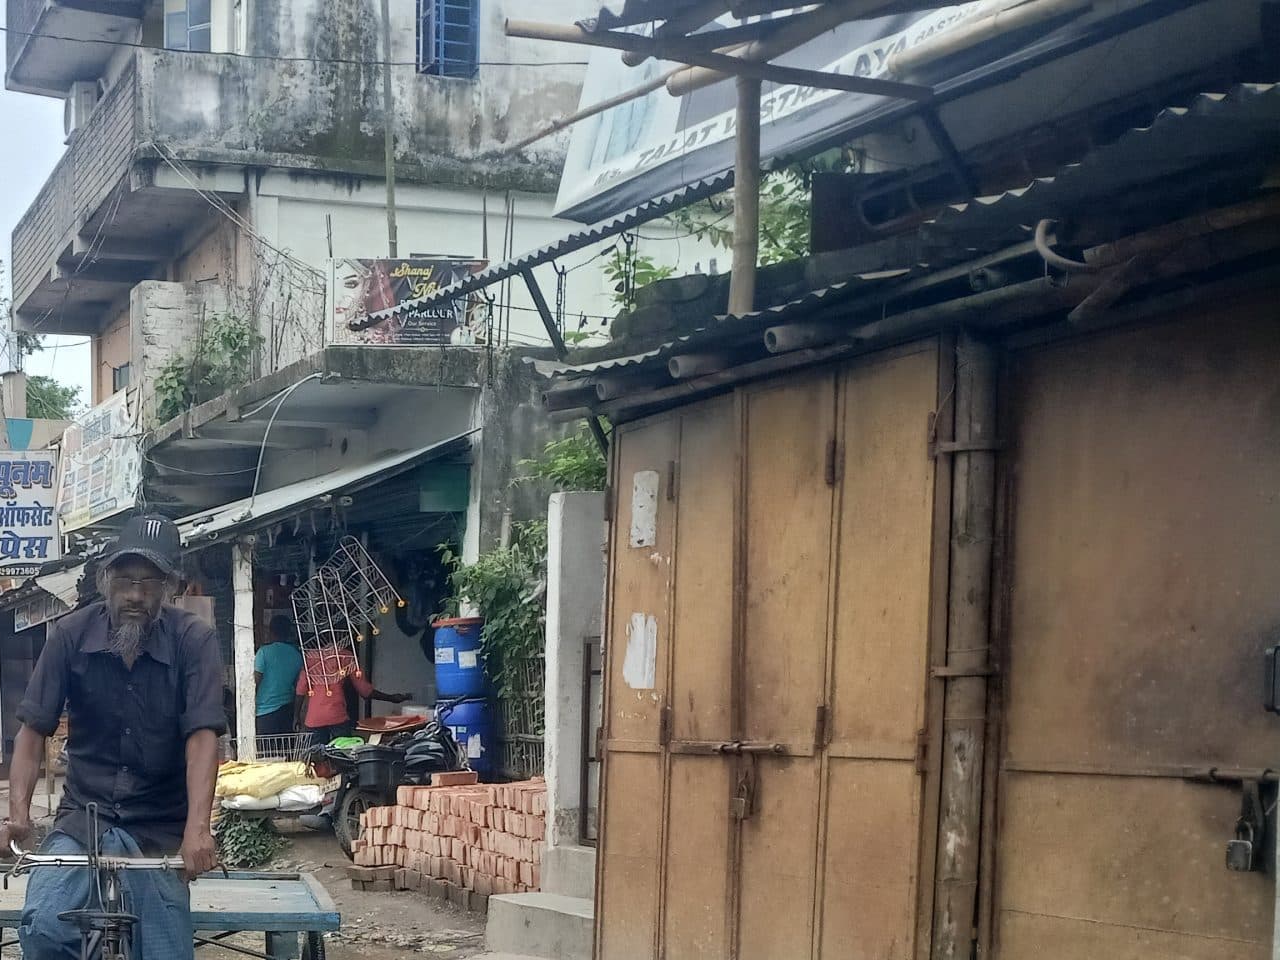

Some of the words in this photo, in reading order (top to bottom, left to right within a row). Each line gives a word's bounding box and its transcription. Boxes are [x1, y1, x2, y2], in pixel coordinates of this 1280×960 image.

[634, 122, 719, 169] TALAT
[390, 262, 434, 280] Shanaj
[5, 566, 43, 577] 9973605
